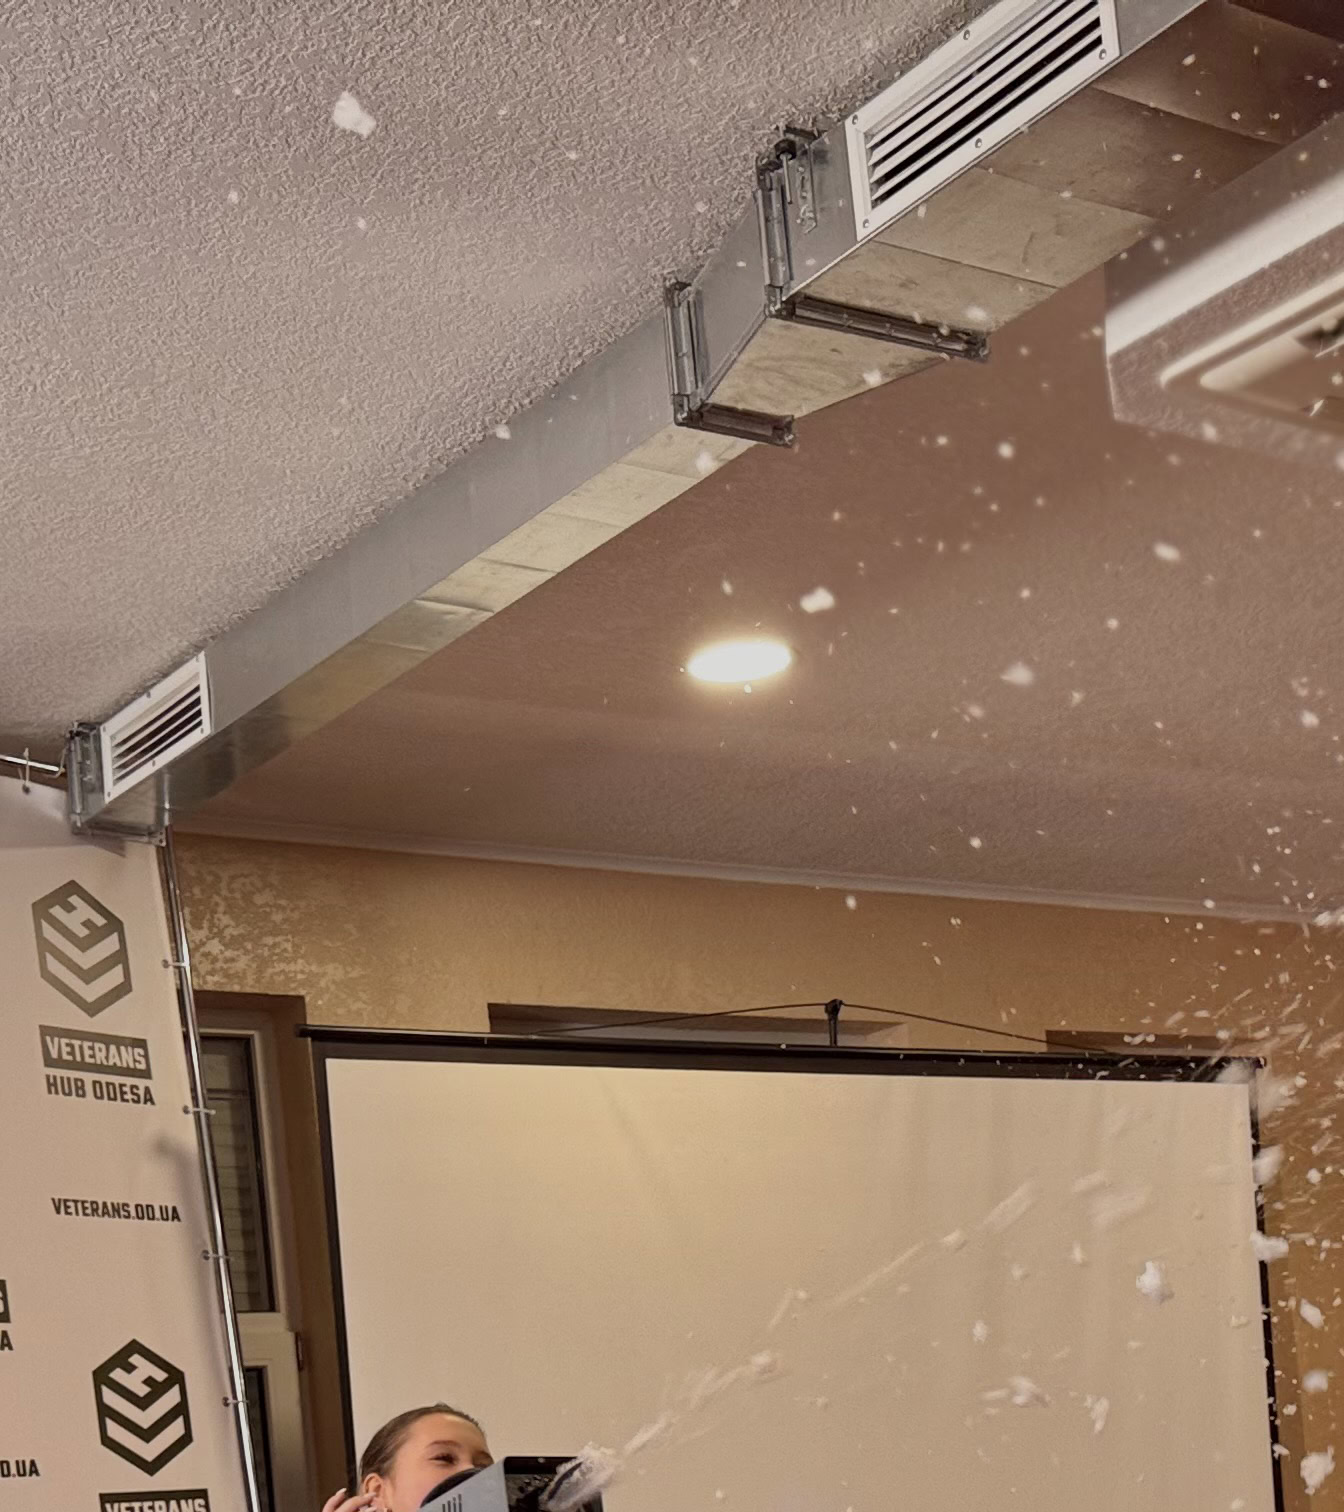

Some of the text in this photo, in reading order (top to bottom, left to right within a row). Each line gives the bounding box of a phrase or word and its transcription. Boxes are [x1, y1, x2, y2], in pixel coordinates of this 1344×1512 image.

[46, 1036, 146, 1069] VETERANS
[46, 1074, 155, 1105] HUB ODESA
[51, 1198, 181, 1222] VETERANS.OD.UA
